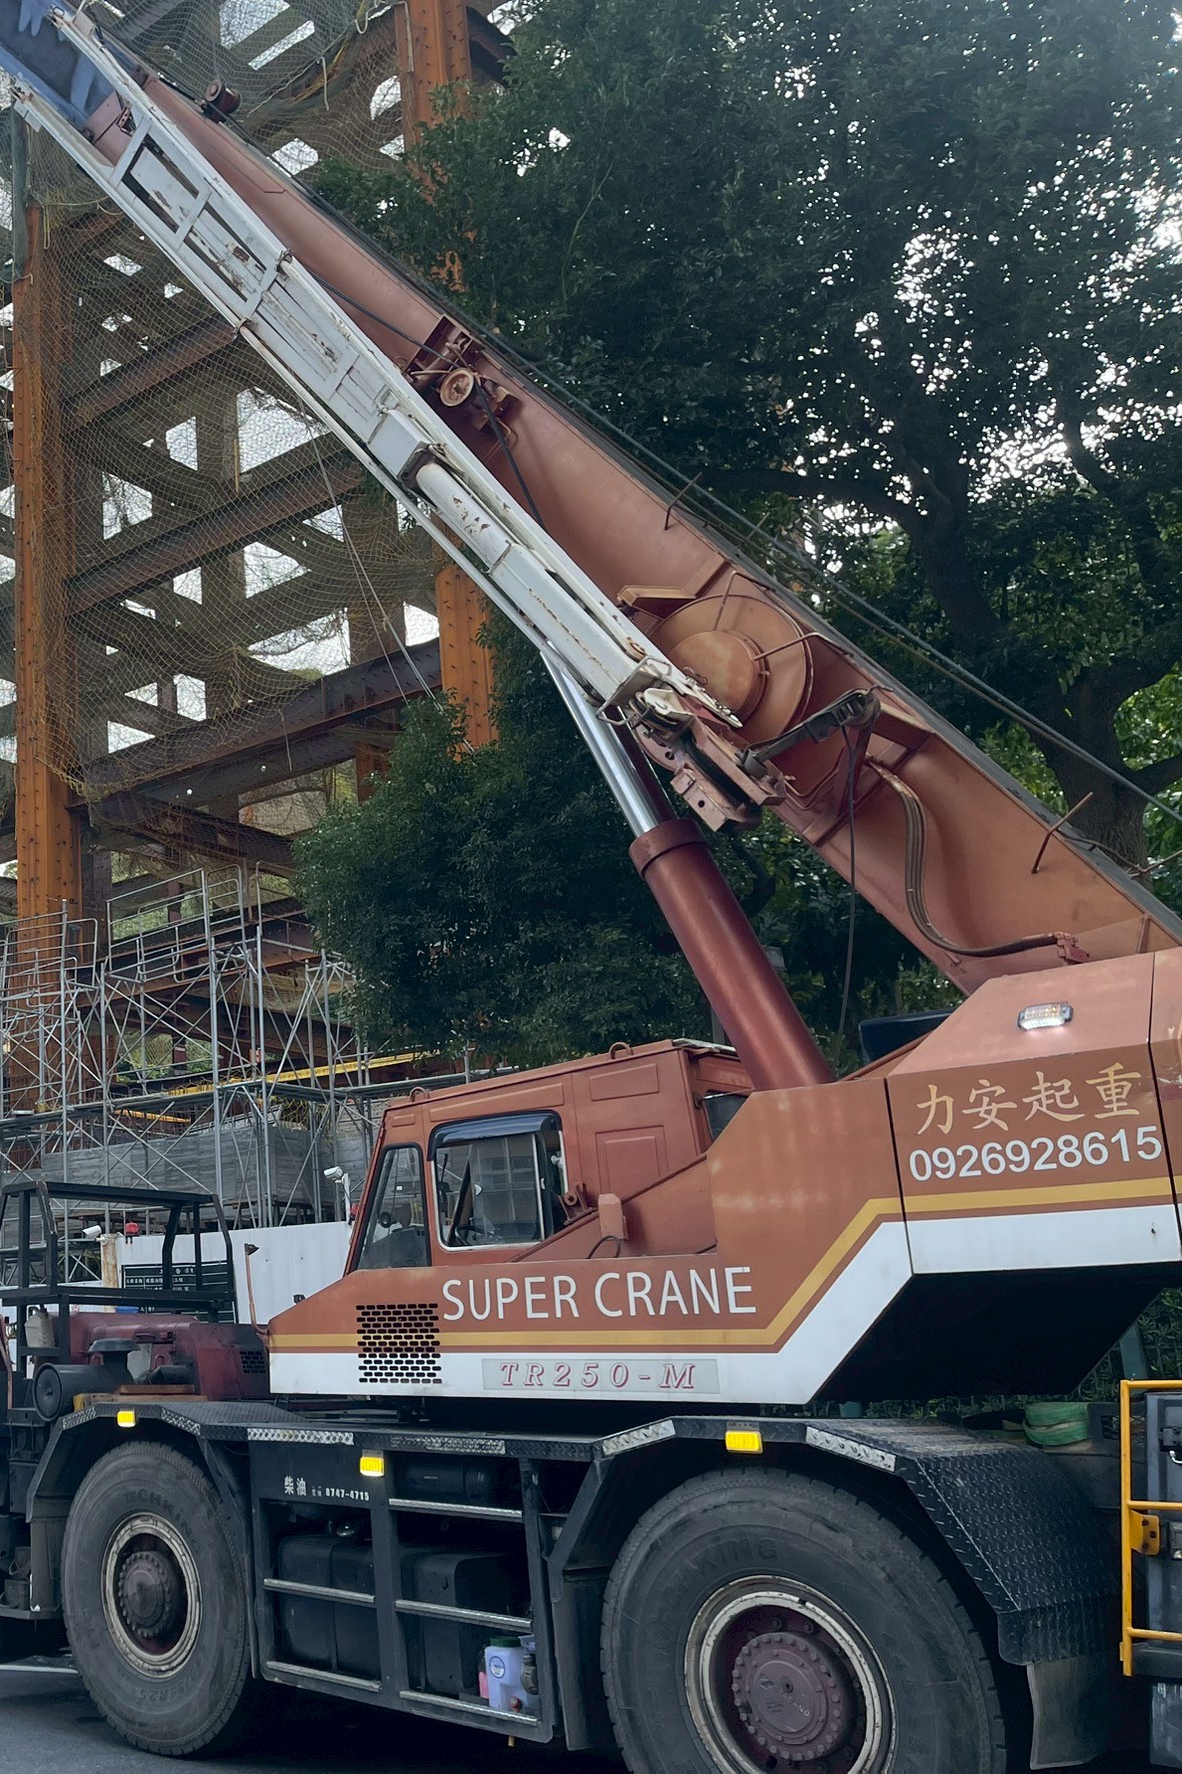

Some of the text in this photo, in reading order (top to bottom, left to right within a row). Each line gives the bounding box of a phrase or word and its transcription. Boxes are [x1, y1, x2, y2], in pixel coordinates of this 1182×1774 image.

[916, 1061, 1142, 1135] 力安起重
[909, 1125, 1162, 1182] 0926928615
[442, 1266, 757, 1321] SUPER CRANE
[499, 1362, 696, 1389] TR250-M
[284, 1475, 307, 1497] 柴油
